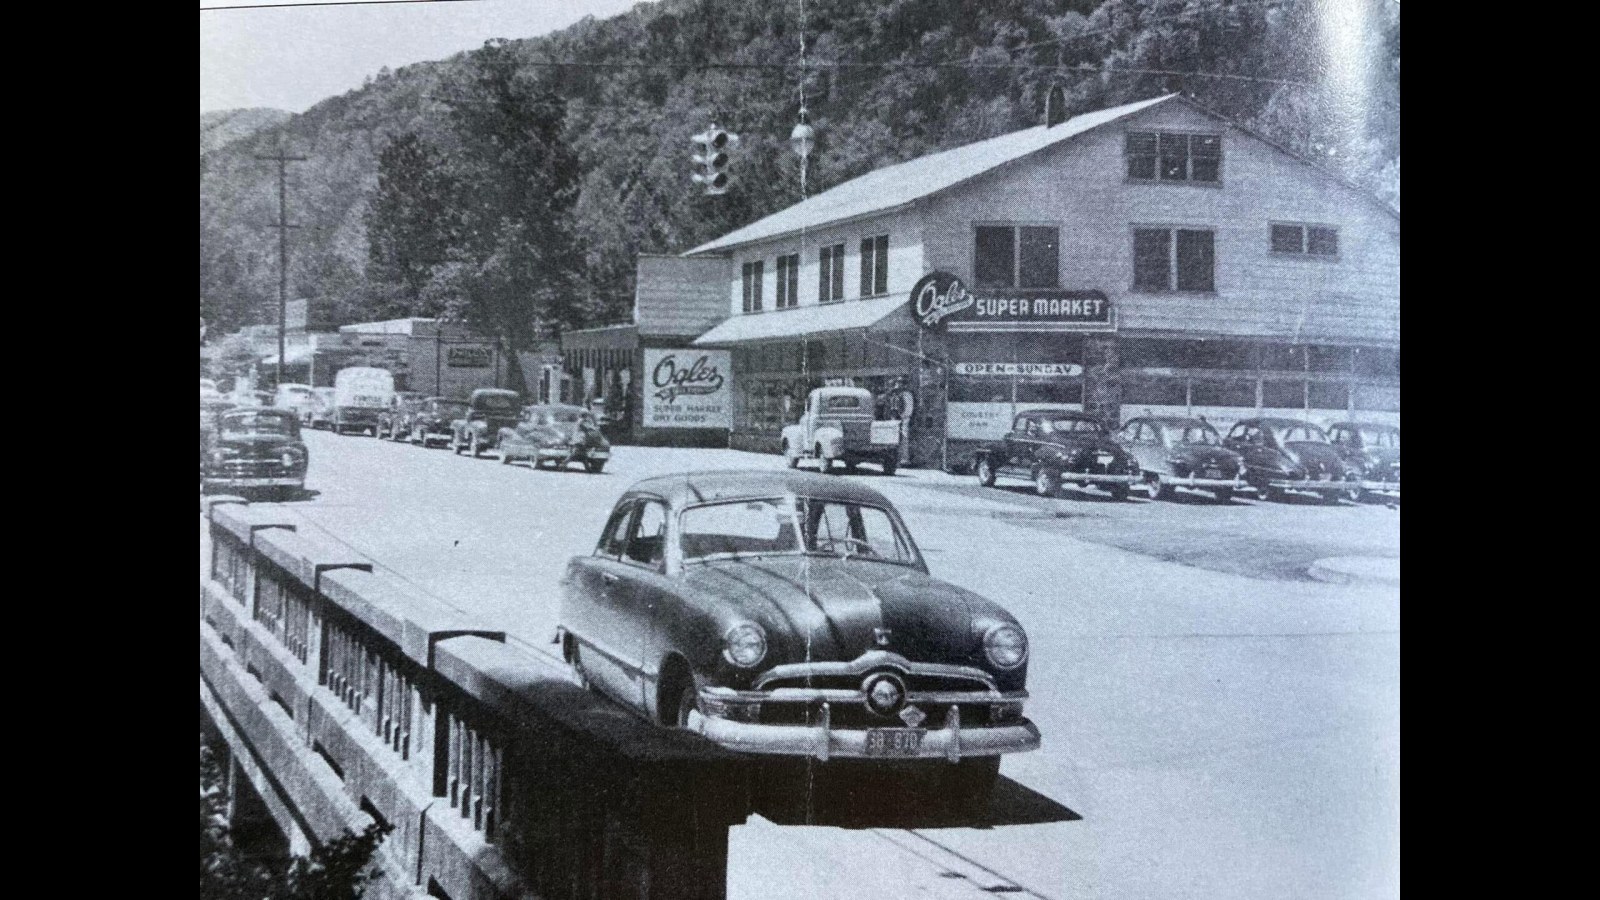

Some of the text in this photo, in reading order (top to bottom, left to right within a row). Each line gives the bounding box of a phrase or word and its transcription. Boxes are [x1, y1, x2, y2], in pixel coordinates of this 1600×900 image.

[917, 279, 1104, 322] Ogles SUPER MARKET
[653, 354, 722, 394] Ogles
[653, 405, 722, 413] SUPER MARKET
[674, 414, 706, 423] GOODS
